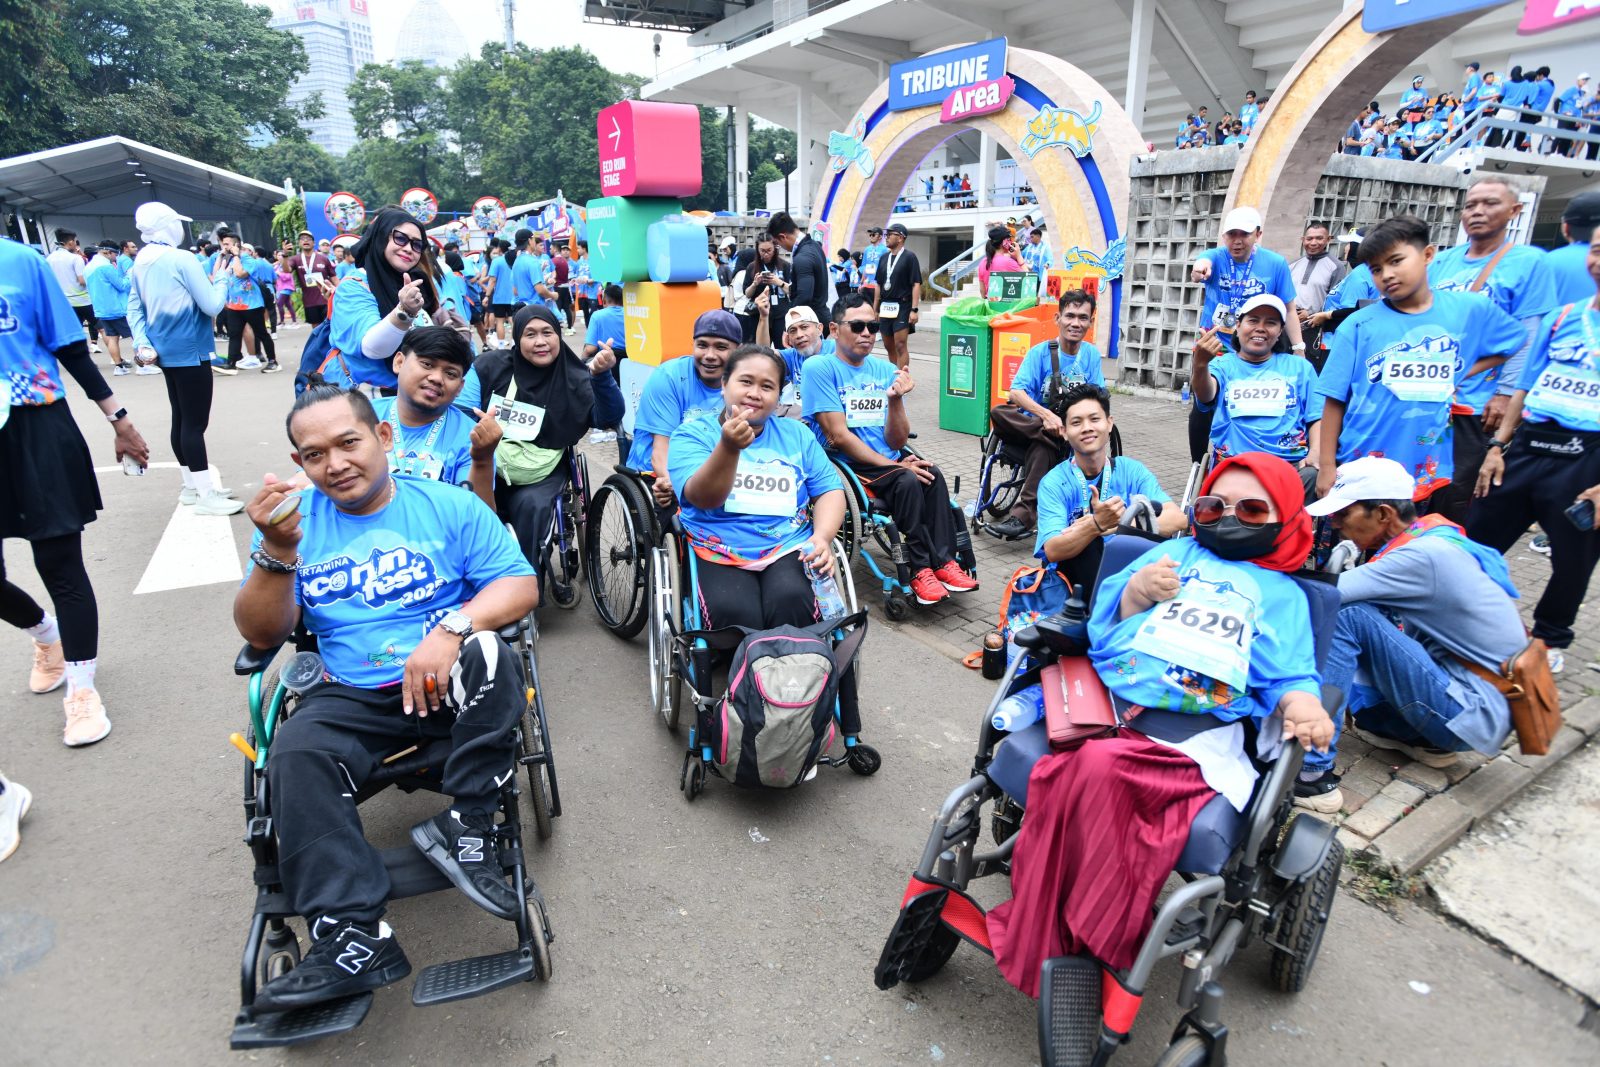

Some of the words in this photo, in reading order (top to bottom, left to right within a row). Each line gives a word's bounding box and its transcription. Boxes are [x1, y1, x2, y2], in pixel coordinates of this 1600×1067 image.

[901, 54, 990, 97] TRIBUNE
[950, 82, 1000, 116] Area
[602, 159, 614, 173] ECO
[613, 156, 626, 171] RUN
[603, 172, 620, 188] STAGE
[625, 291, 637, 305] ECO
[626, 305, 650, 319] MARKET
[1389, 363, 1450, 379] 56308
[1233, 388, 1280, 400] 56297
[1541, 374, 1600, 398] 56288
[850, 398, 883, 411] 56284
[733, 473, 791, 493] 56290
[299, 556, 349, 577] ERTAMINA
[361, 558, 428, 602] fest
[458, 836, 484, 862] N
[335, 941, 375, 975] N
